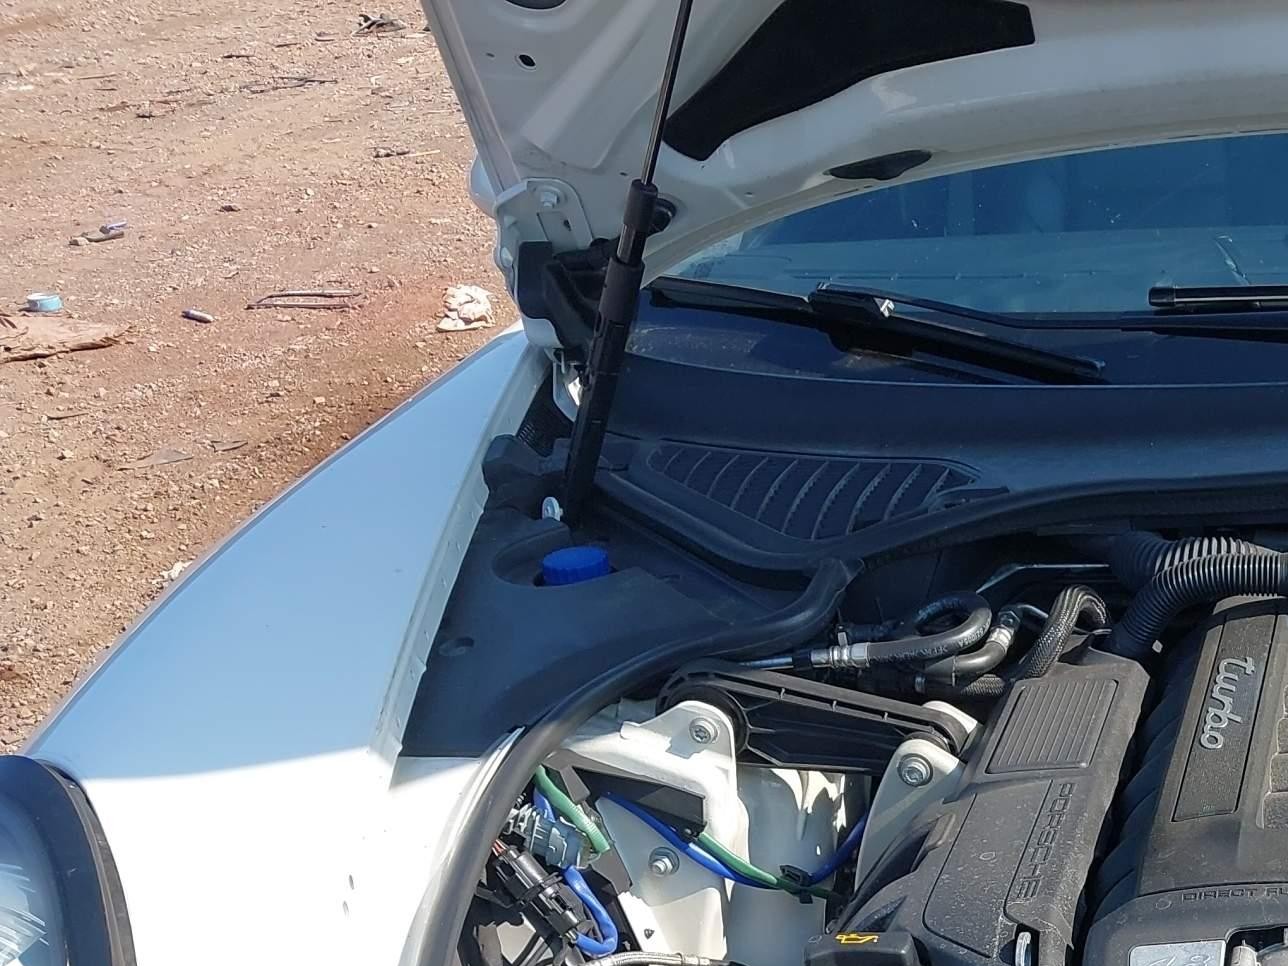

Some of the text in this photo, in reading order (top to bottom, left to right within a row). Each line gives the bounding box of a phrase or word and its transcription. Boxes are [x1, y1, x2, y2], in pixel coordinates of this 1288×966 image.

[1200, 656, 1255, 749] turbo
[1015, 782, 1078, 900] PORSCHE
[1182, 888, 1257, 902] DIRECT
